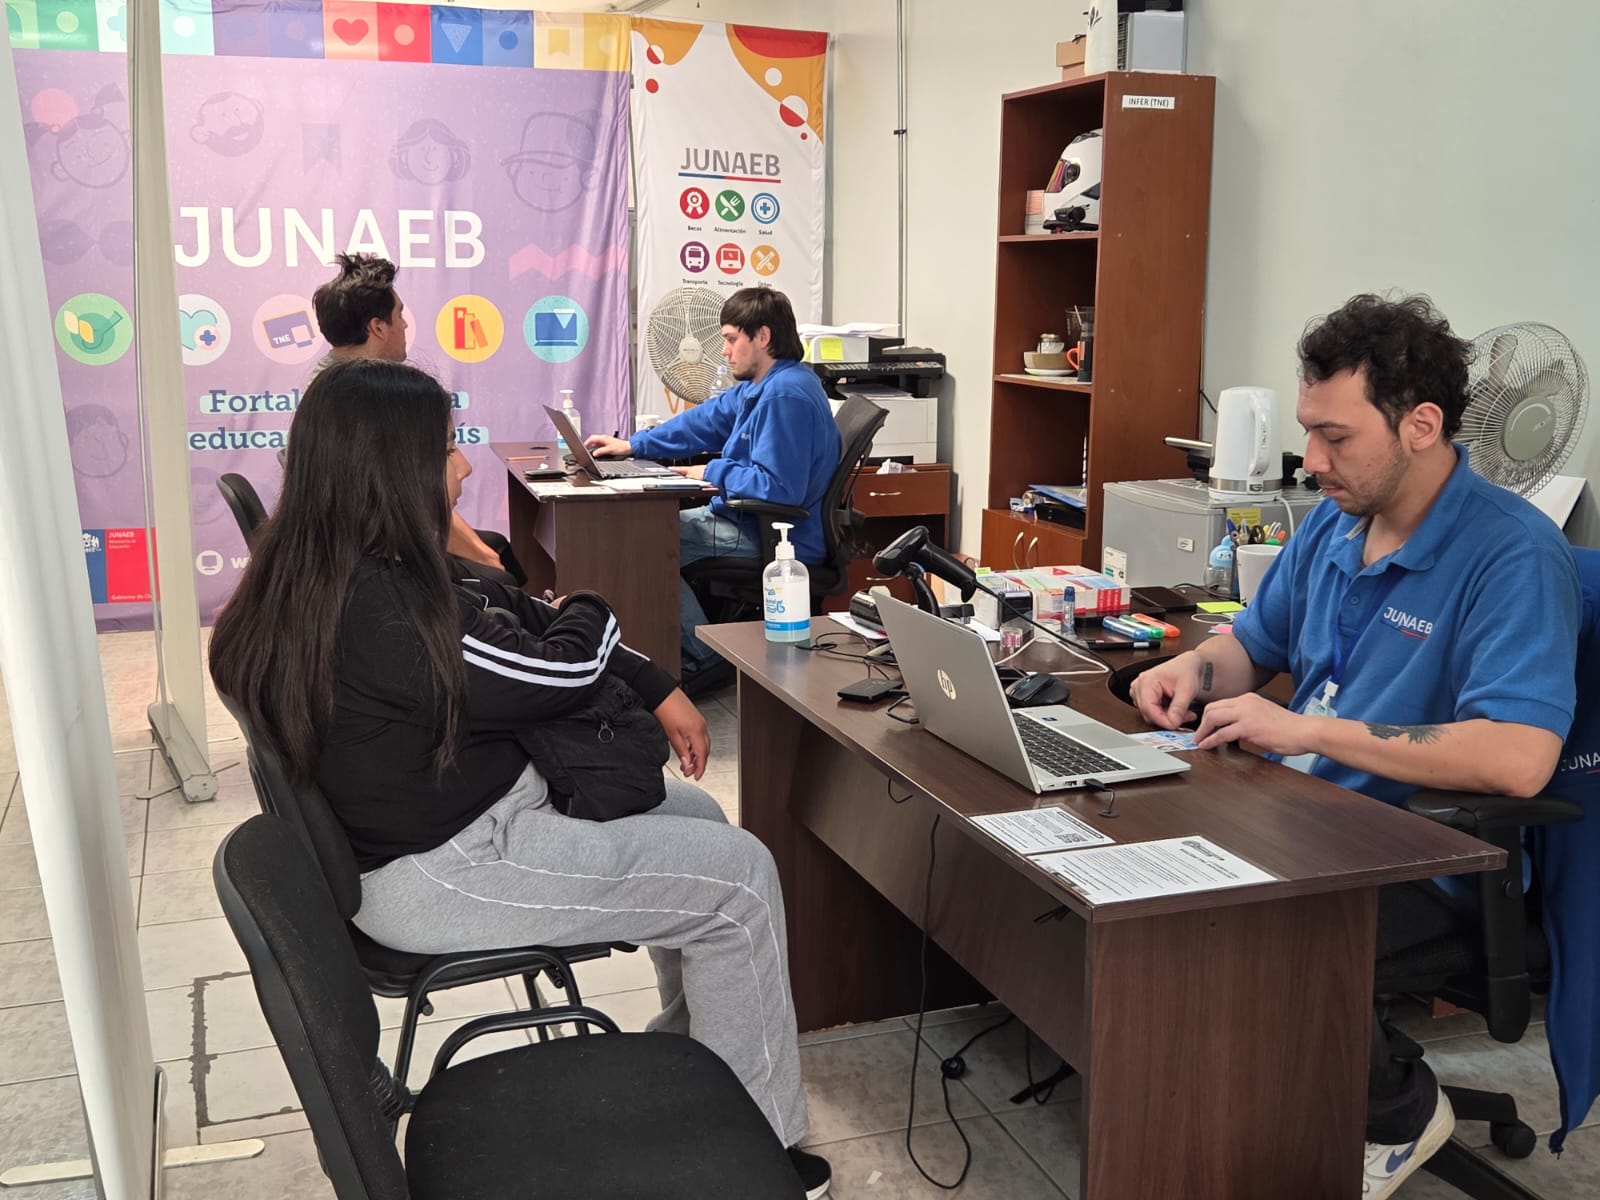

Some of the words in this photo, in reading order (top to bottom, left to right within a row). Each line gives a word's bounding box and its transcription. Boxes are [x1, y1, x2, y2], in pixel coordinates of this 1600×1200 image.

[1128, 98, 1149, 106] INFER
[1150, 99, 1169, 107] (TNE)
[680, 147, 781, 176] JUNAEB
[174, 206, 486, 269] JUNAEB
[272, 334, 291, 345] TNE
[189, 427, 286, 450] educa
[1383, 606, 1433, 634] JUNAEB
[937, 669, 957, 700] hp
